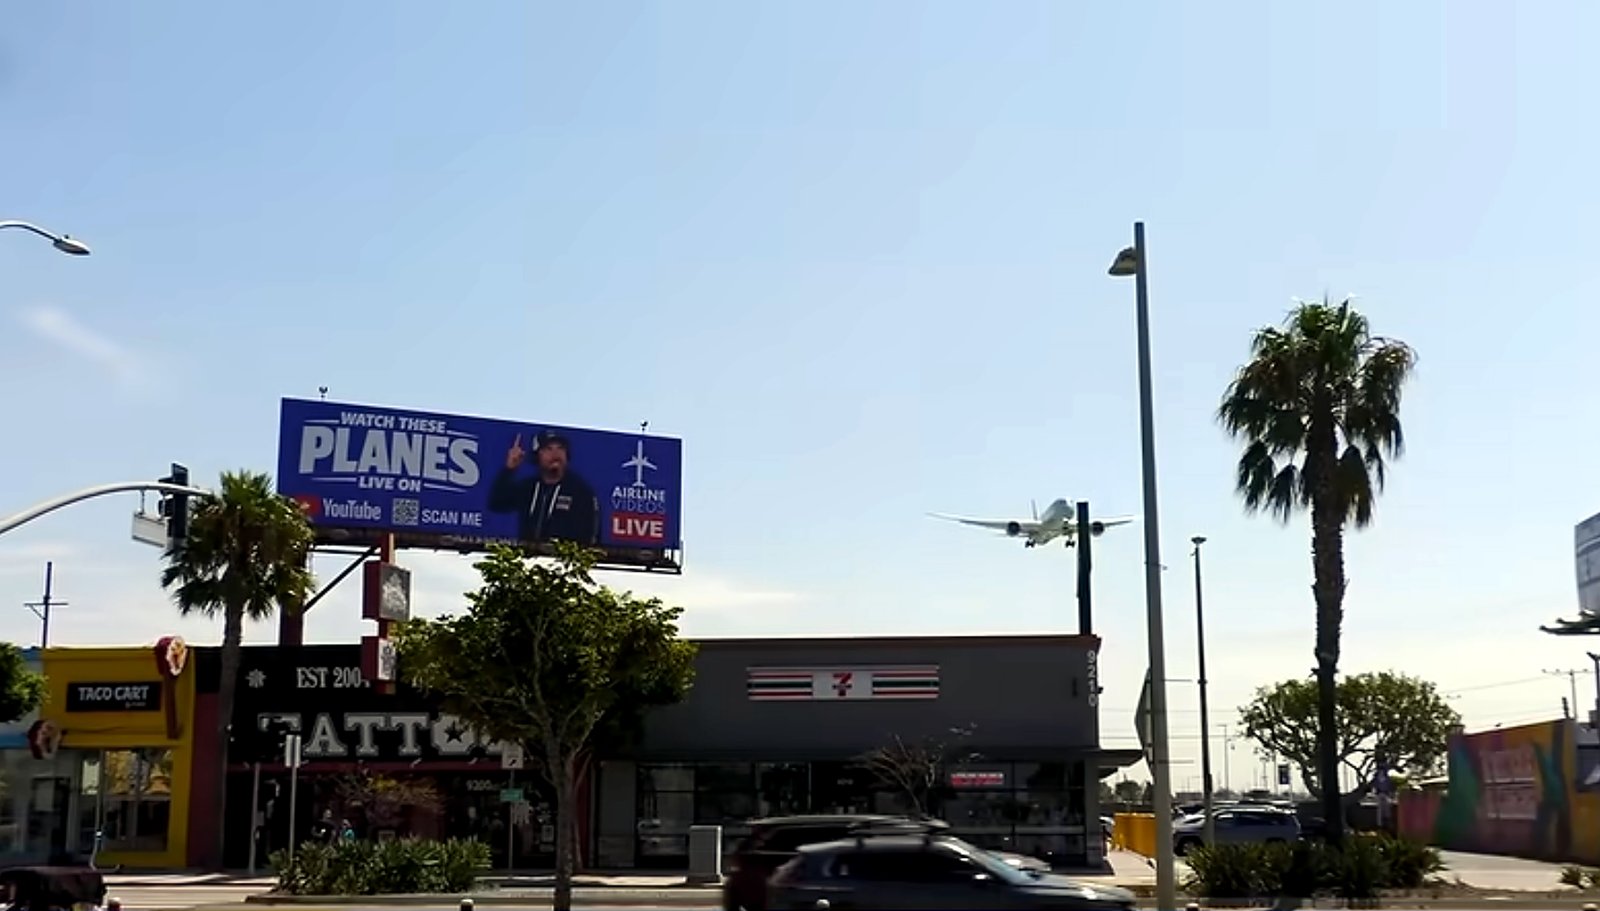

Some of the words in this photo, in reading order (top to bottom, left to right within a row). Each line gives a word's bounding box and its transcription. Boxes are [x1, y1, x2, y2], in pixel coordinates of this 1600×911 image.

[340, 411, 394, 429] WATCH
[399, 417, 447, 433] THESE
[298, 425, 480, 488] PLANES
[358, 475, 394, 491] LIVE
[398, 478, 421, 493] ON
[611, 486, 666, 503] AIRLINE
[322, 497, 382, 520] YouTube
[611, 499, 666, 514] VIDEOS
[421, 508, 458, 525] SCAN
[461, 511, 482, 527] ME
[612, 517, 664, 538] LIVE
[296, 666, 329, 689] EST
[1086, 650, 1098, 708] 9210
[77, 686, 112, 702] TACO
[114, 684, 150, 701] CART
